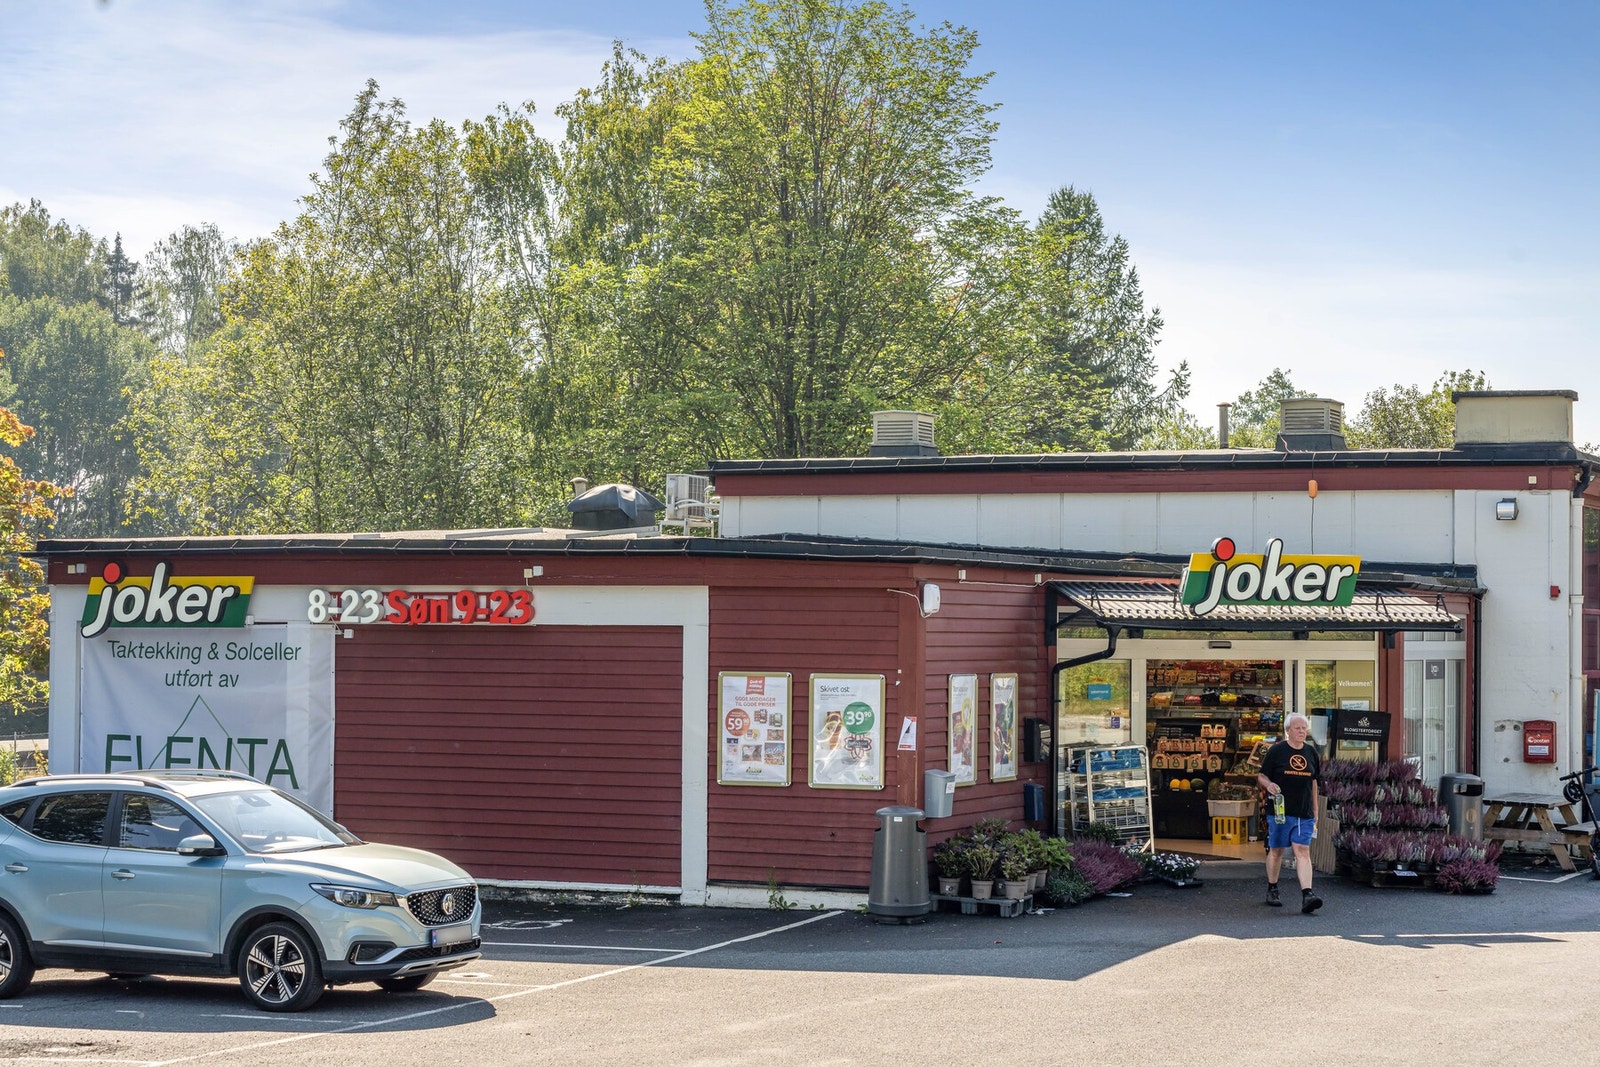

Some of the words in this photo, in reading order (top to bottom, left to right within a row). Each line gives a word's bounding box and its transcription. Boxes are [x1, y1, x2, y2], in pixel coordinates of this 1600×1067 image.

[1194, 537, 1355, 616] joker
[81, 561, 240, 639] joker
[307, 589, 384, 623] 8-23
[387, 589, 449, 625] Søn
[455, 589, 535, 624] 9-23
[108, 640, 202, 665] Taktekking
[207, 642, 219, 660] &
[225, 642, 302, 661] Solceller
[165, 669, 213, 687] utført
[218, 674, 240, 688] av
[820, 685, 840, 693] Skivet
[840, 685, 850, 693] ost
